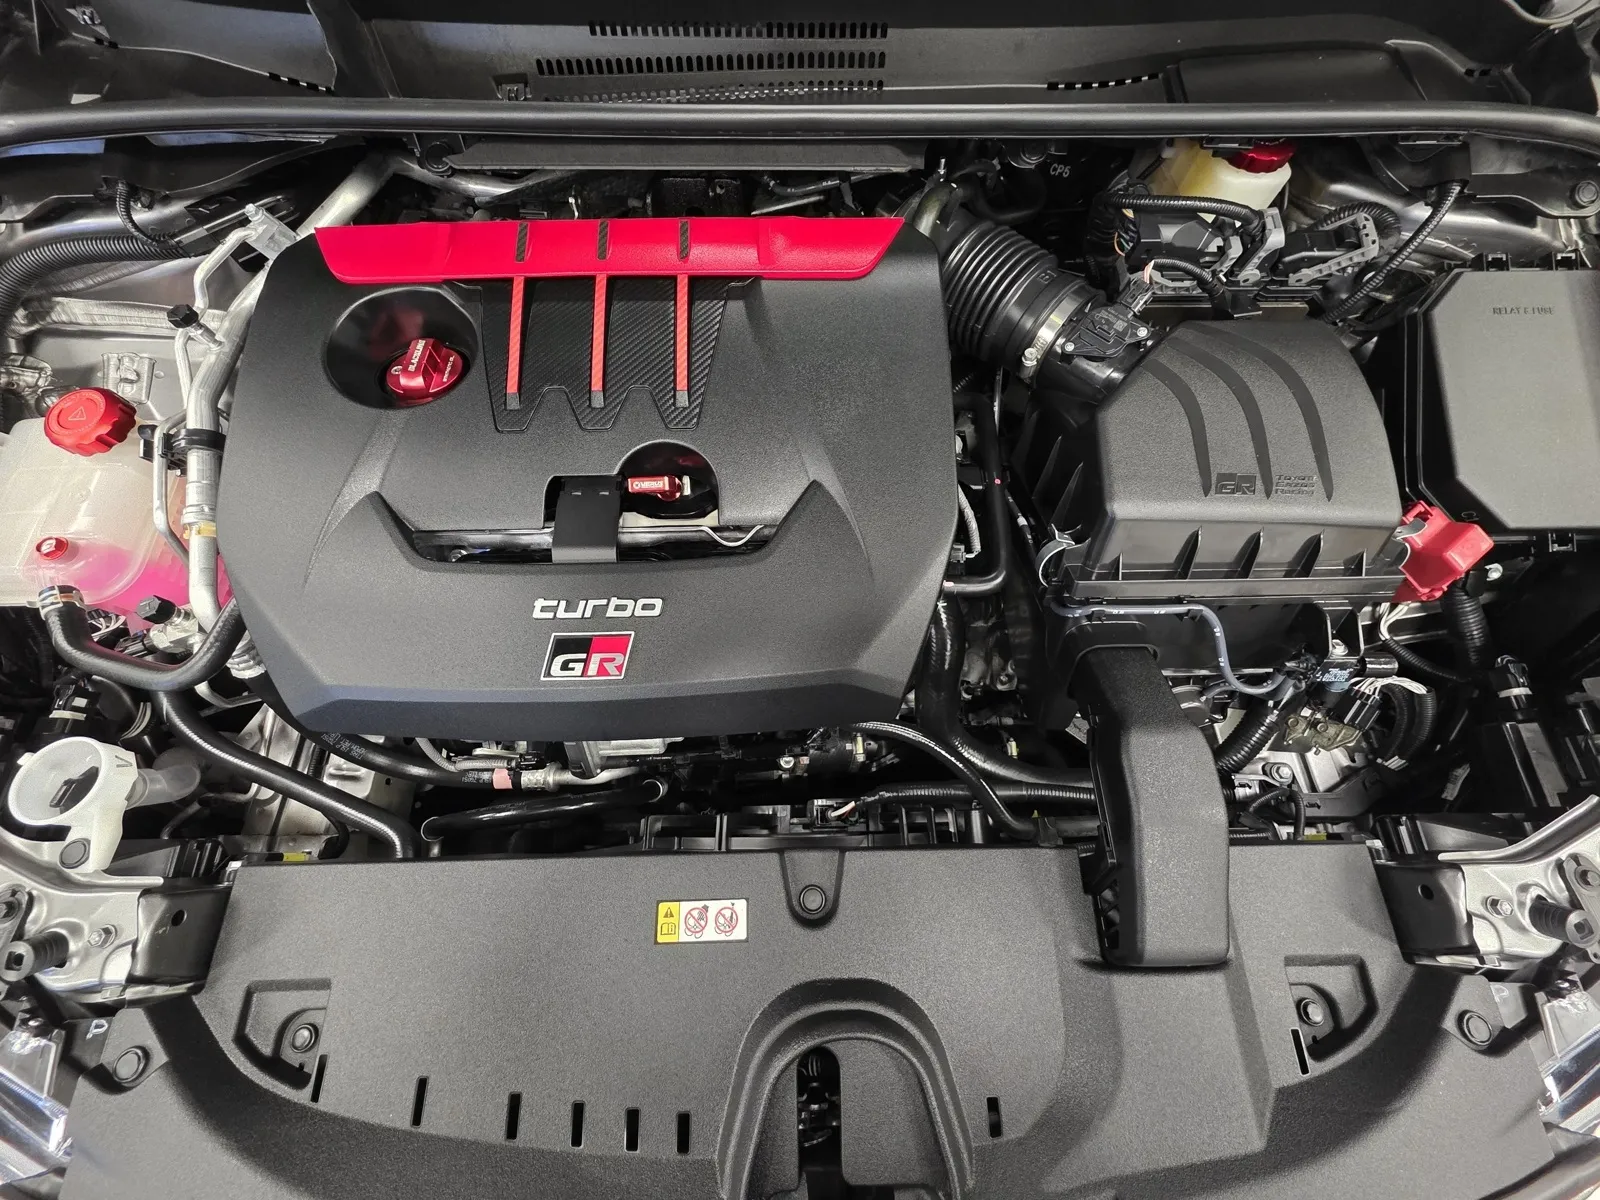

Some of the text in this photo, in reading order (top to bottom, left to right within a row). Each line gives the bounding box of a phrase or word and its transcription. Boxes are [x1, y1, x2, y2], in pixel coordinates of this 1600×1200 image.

[1218, 481, 1255, 495] GR
[532, 597, 663, 619] turbo
[550, 653, 625, 677] GR
